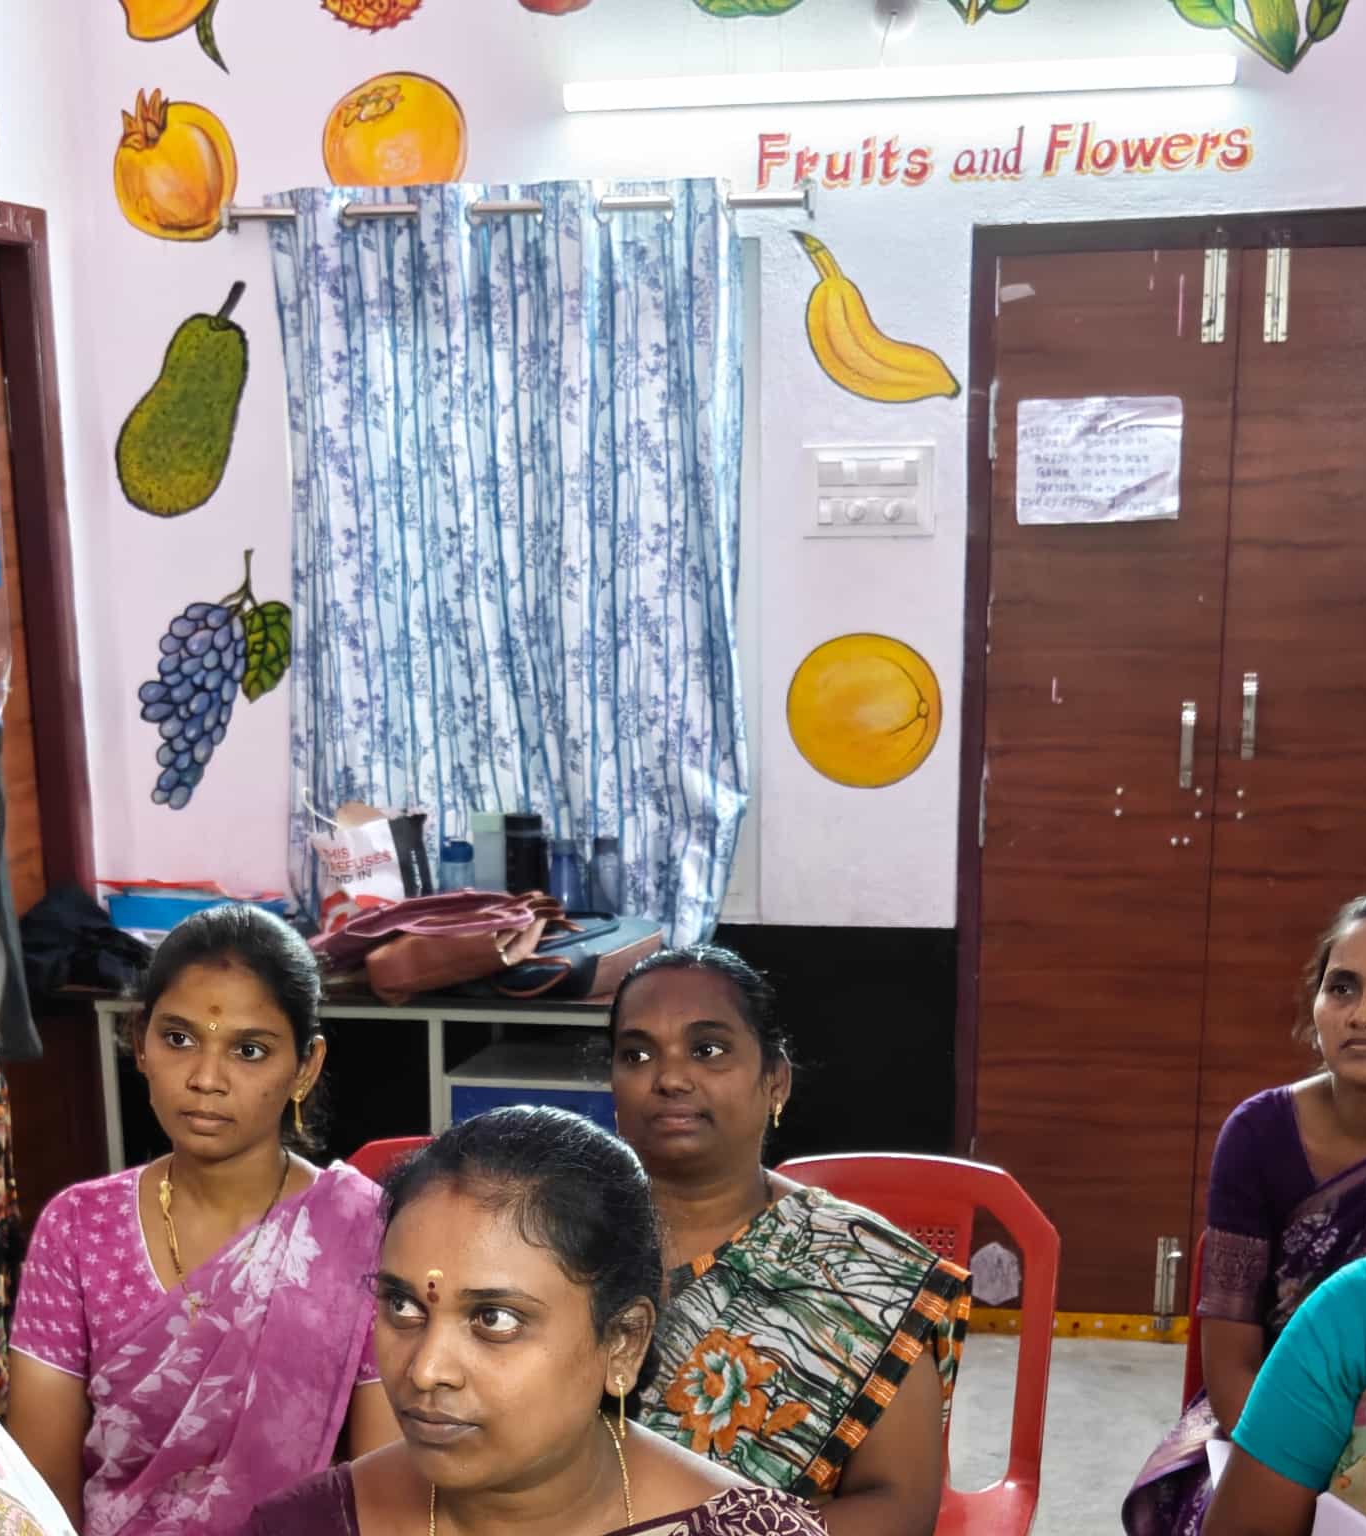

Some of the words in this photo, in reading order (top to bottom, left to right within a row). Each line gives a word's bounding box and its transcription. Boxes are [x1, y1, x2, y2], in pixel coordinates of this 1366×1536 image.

[756, 132, 934, 190] Fruits
[949, 126, 1025, 183] and
[1042, 122, 1253, 176] Flowers
